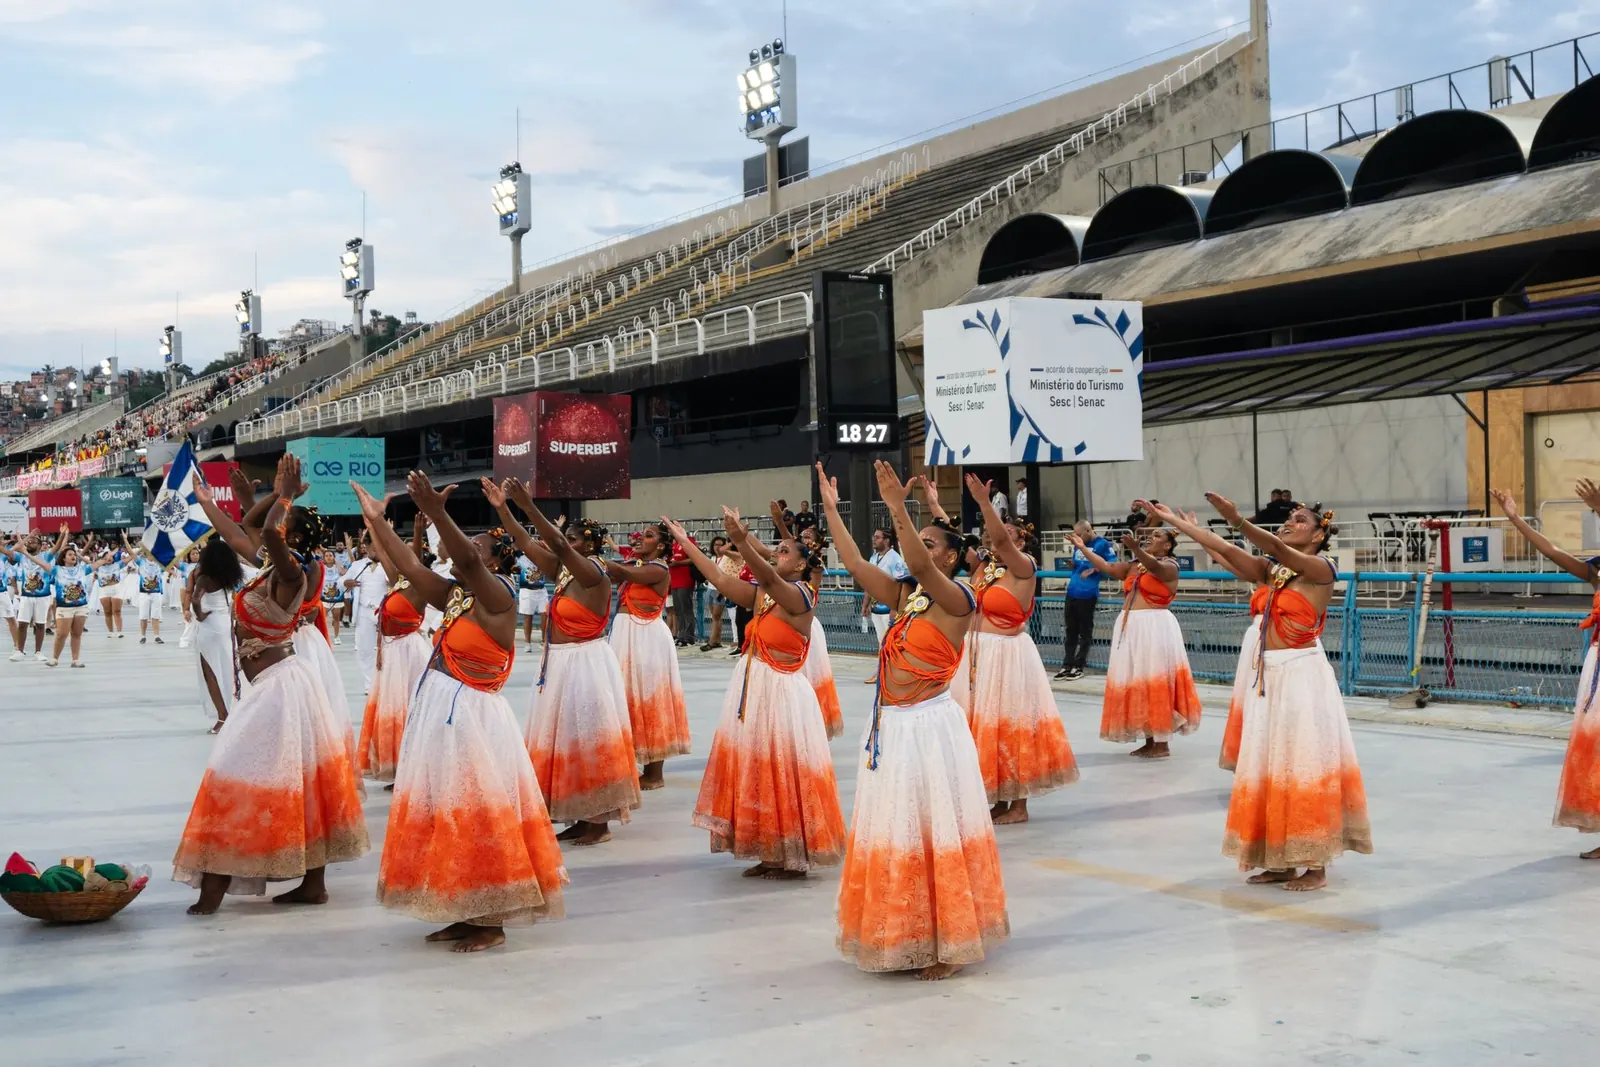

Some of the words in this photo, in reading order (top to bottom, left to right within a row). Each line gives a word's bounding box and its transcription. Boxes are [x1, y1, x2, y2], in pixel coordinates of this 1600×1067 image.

[1045, 366, 1066, 374] acordo
[1067, 366, 1074, 374] de
[1075, 366, 1109, 376] cooperação
[936, 384, 965, 397] Ministério
[966, 384, 973, 394] do
[974, 382, 996, 394] Turismo
[1030, 378, 1075, 390] Ministério
[1076, 380, 1087, 390] do
[1088, 380, 1124, 391] Turismo
[948, 401, 963, 412] Sesc
[966, 400, 985, 411] Senac
[1049, 395, 1071, 407] Sesc
[1078, 395, 1105, 407] Senac
[839, 424, 861, 443] 18
[865, 424, 888, 443] 27
[498, 441, 531, 456] SUPERBET
[549, 440, 618, 455] SUPERBET
[349, 461, 382, 476] RIO
[112, 490, 134, 501] Light
[41, 506, 77, 518] BRAHMA
